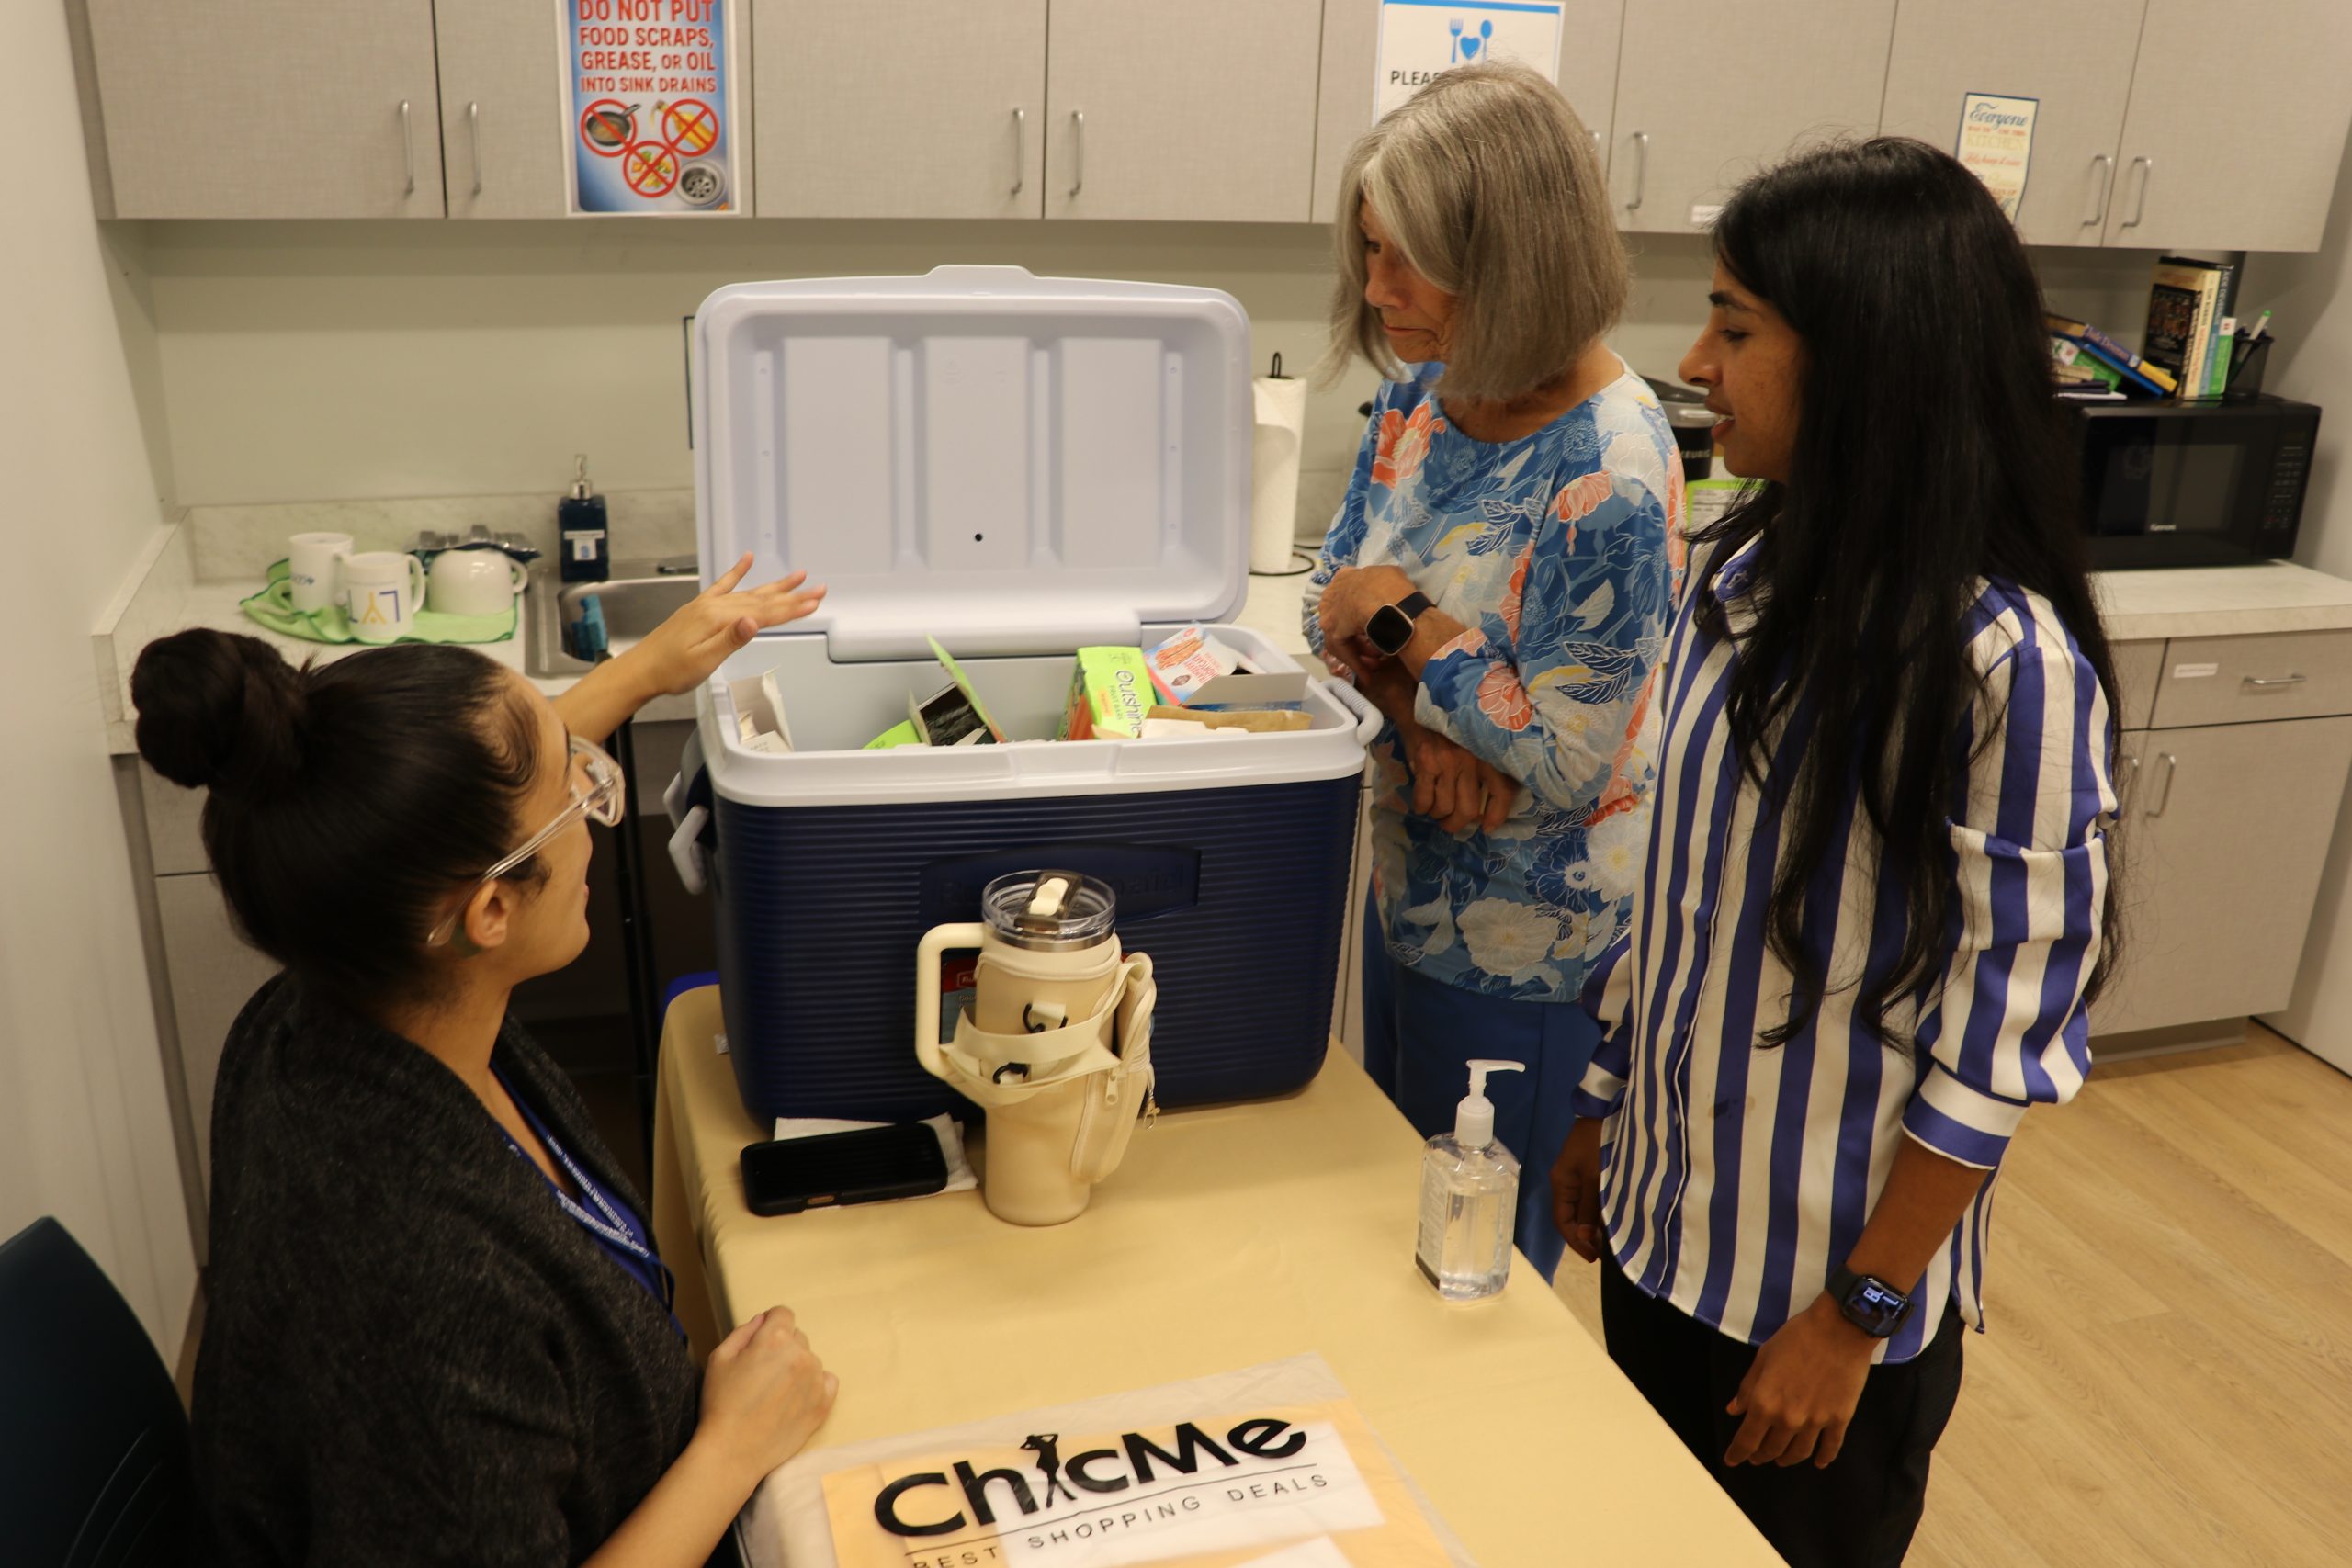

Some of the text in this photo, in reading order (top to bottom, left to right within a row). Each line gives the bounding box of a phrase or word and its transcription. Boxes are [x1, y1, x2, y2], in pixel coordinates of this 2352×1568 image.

[579, 0, 714, 22] DO NOT PUT
[579, 27, 715, 49] FOOD SCRAPS,
[581, 51, 717, 72] GREASE, OR OIL
[581, 76, 717, 93] INTO SINK DRAINS
[1390, 70, 1442, 85] PLEAS
[1969, 102, 2029, 130] Everyone
[1114, 669, 1145, 738] Outshine
[1027, 1495, 1201, 1550] SHOPPING
[1227, 1474, 1329, 1504] DEALS
